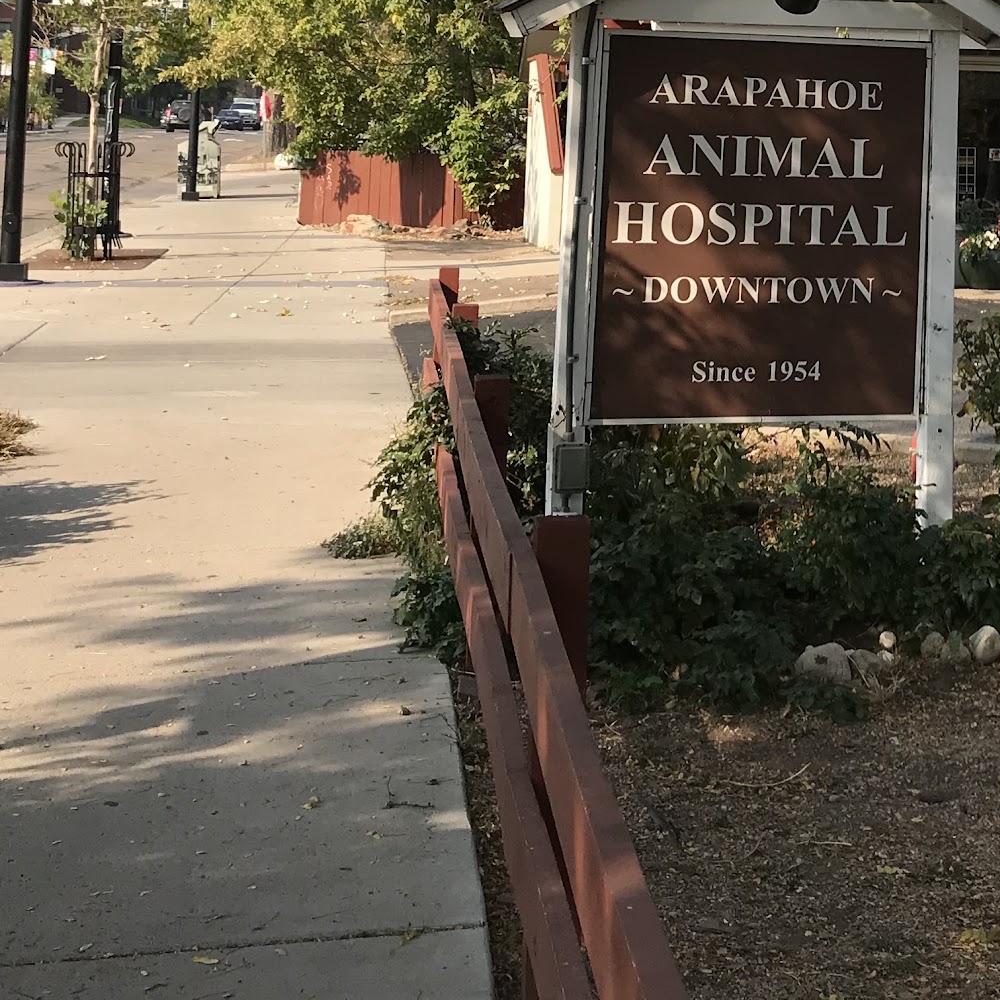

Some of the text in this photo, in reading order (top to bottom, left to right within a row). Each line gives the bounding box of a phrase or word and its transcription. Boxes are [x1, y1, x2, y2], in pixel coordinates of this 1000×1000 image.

[648, 73, 884, 112] ARAPAHOE
[642, 133, 885, 180] ANIMAL
[611, 200, 908, 247] HOSPITAL
[641, 275, 875, 305] DOWNTOWN
[691, 359, 821, 384] Since 1954
